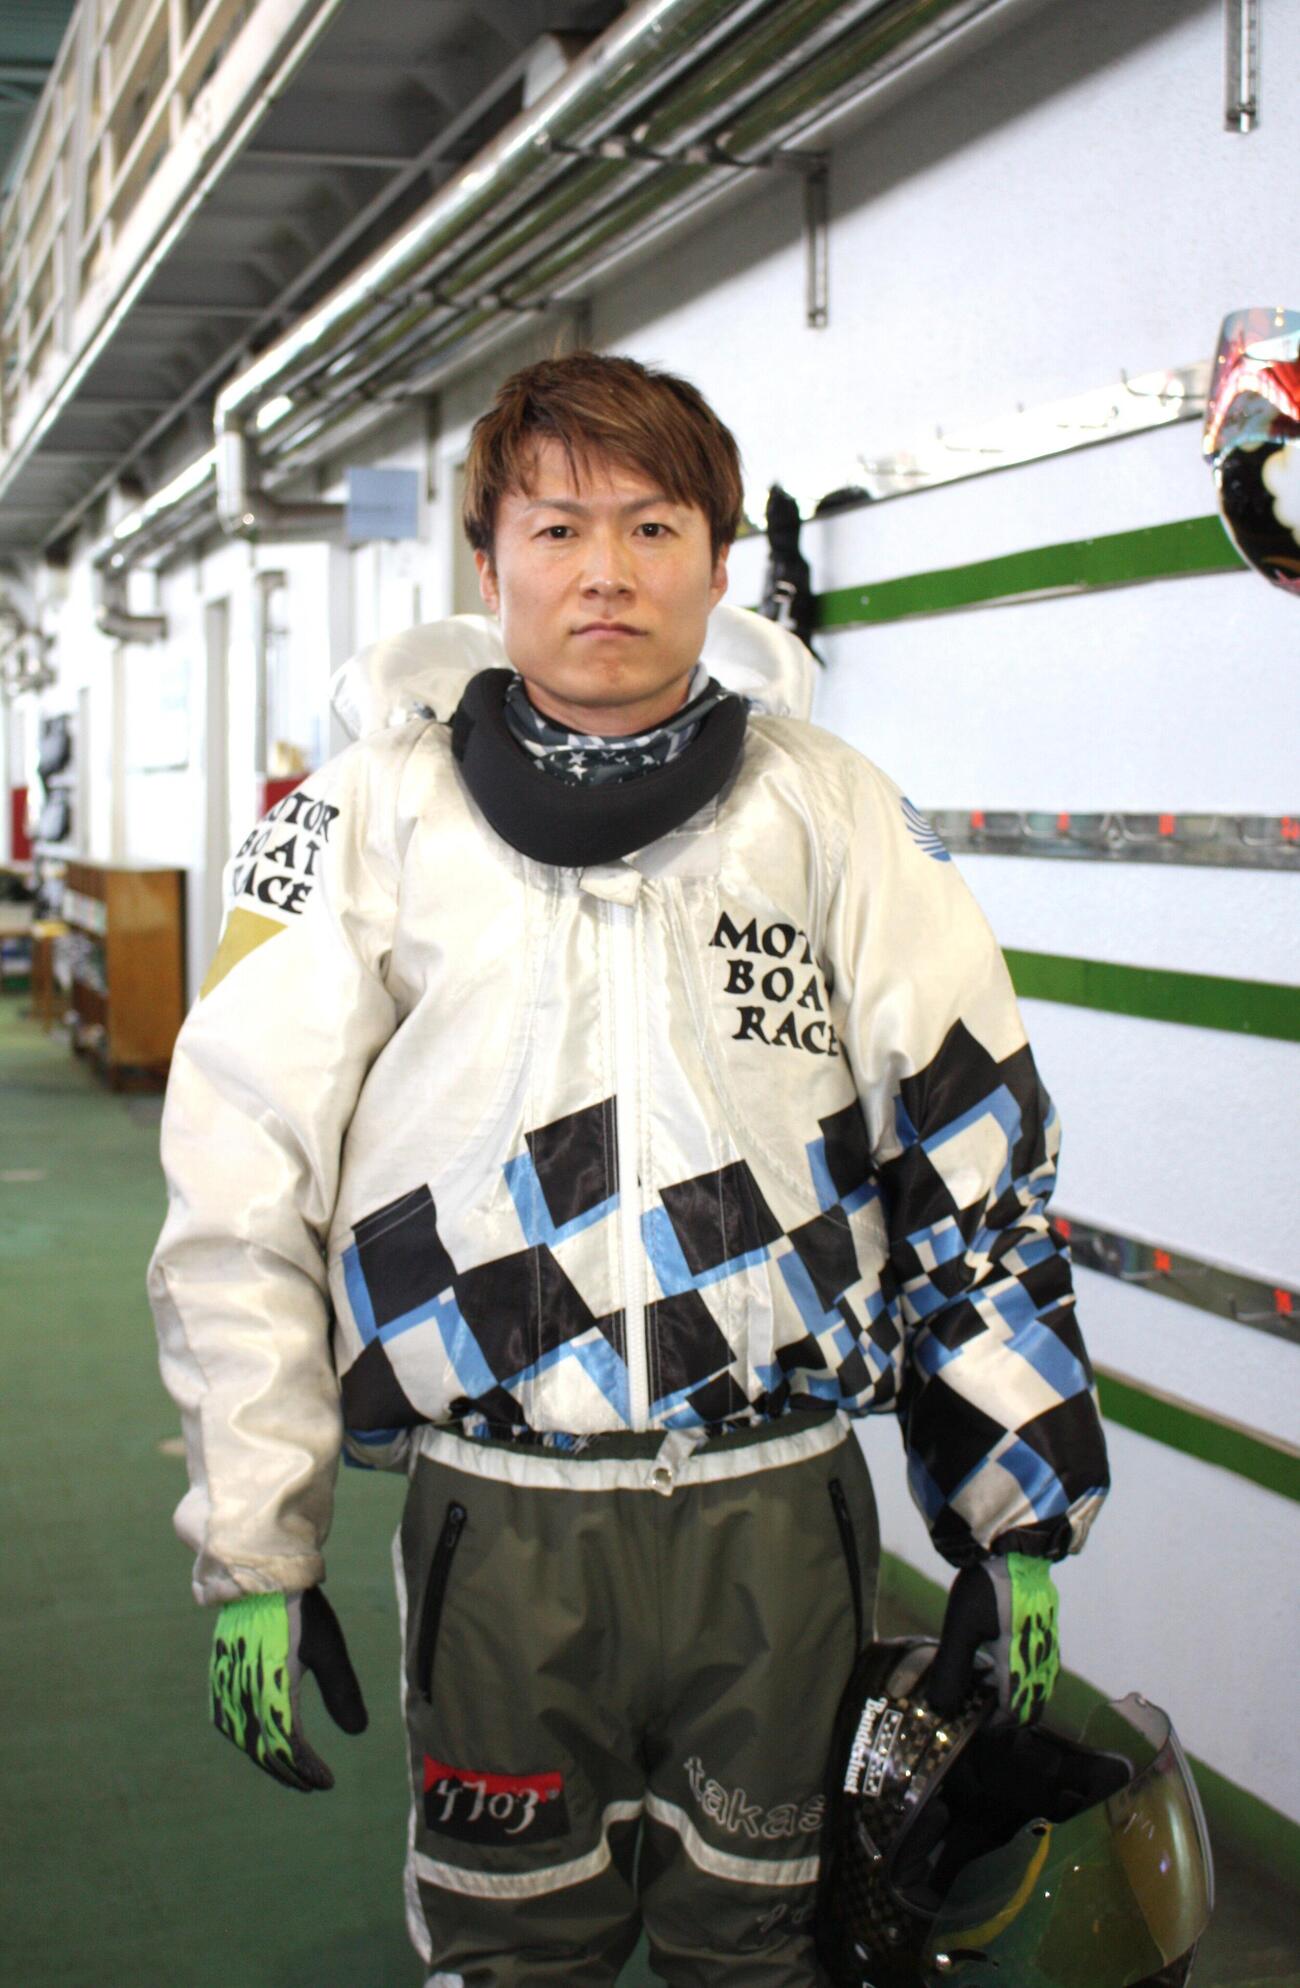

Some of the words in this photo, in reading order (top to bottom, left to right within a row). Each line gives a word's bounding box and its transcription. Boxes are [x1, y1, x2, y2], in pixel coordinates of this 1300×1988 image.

[266, 792, 340, 842] OTOR
[708, 910, 814, 964] MOT
[723, 959, 824, 1012] BOA
[437, 1779, 539, 1834] 4703
